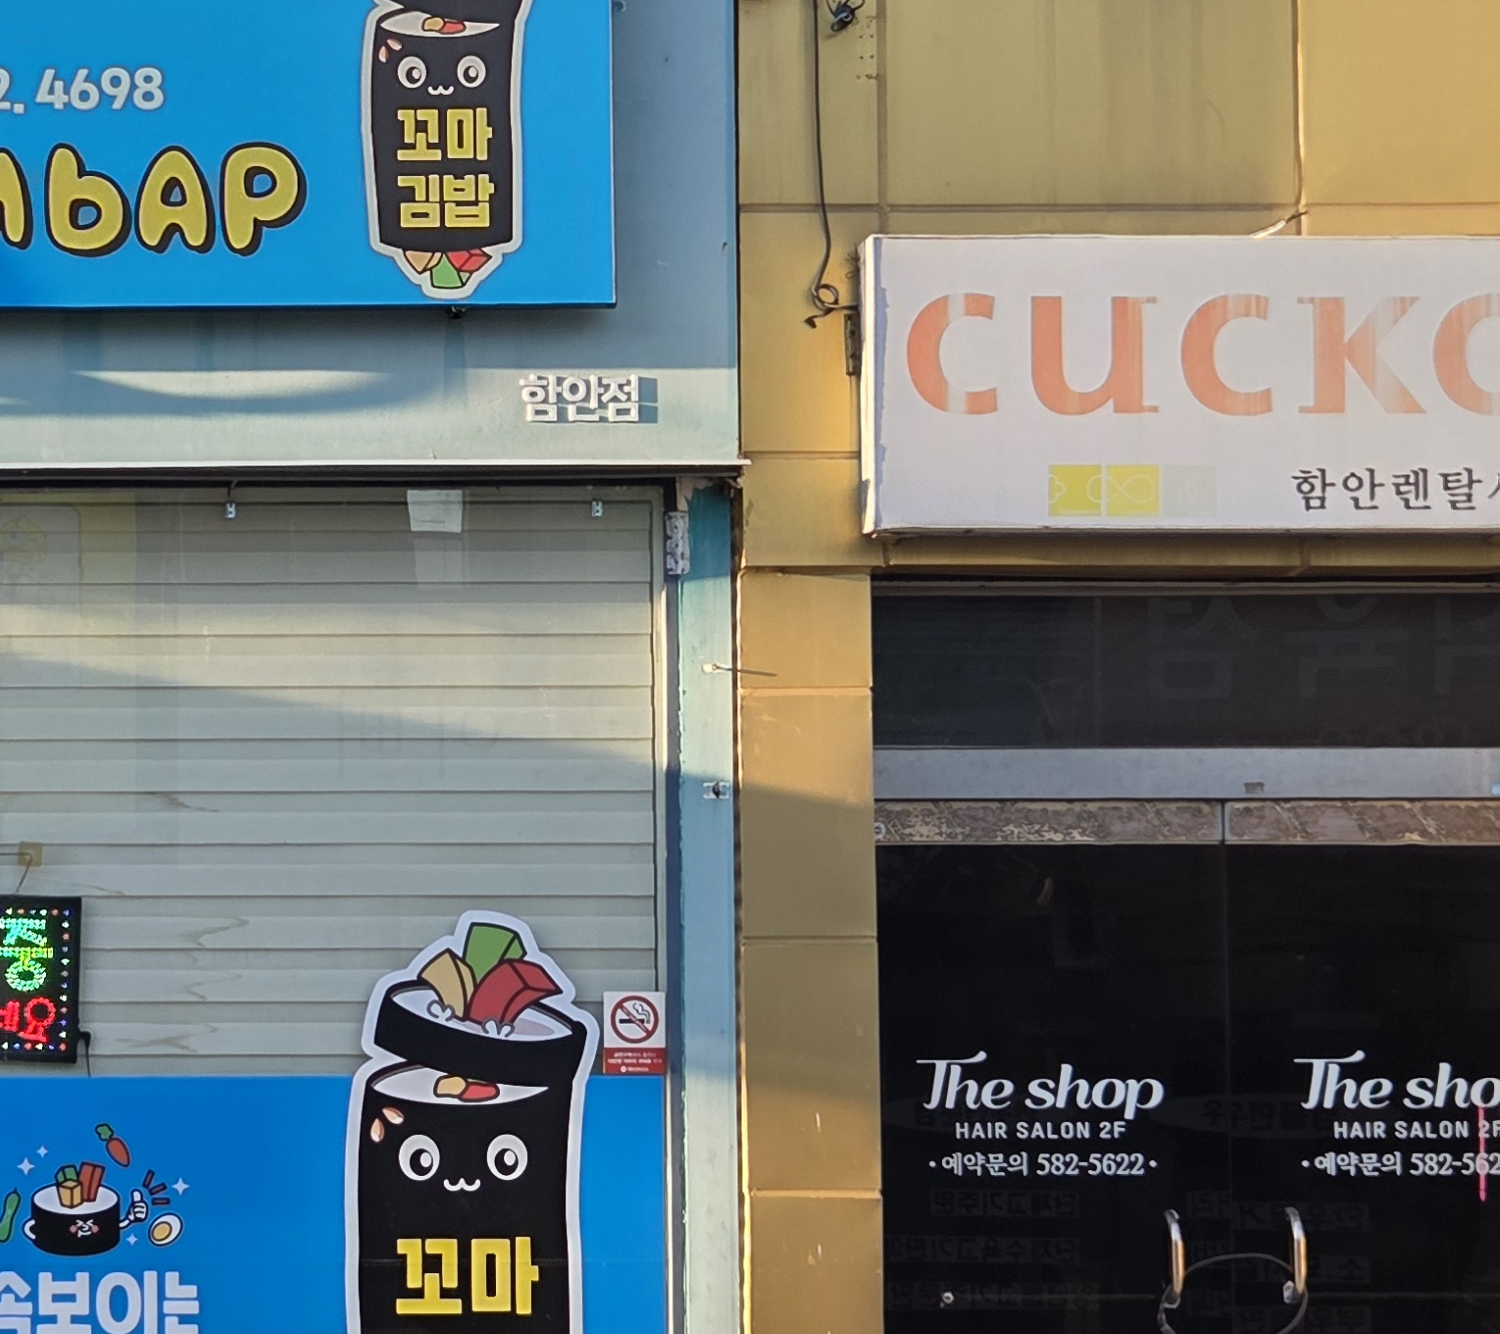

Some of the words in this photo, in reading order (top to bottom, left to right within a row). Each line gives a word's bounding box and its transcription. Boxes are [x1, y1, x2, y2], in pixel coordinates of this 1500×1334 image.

[396, 107, 493, 161] 꼬마
[396, 172, 495, 230] 김밥
[519, 373, 640, 423] 함안점
[1291, 467, 1500, 512] 함안렌탈
[916, 1050, 1015, 1110] The
[1024, 1063, 1165, 1120] shop
[1293, 1049, 1394, 1110] The
[955, 1121, 1008, 1139] HAIR
[1016, 1121, 1090, 1139] SALON
[1099, 1120, 1127, 1139] 2F
[1333, 1120, 1387, 1139] HAIR
[1394, 1120, 1469, 1139] SALON
[941, 1151, 1029, 1177] 예약문의
[1036, 1153, 1145, 1176] 582-5622
[1314, 1151, 1403, 1177] 예약문의
[396, 1235, 540, 1316] 꼬마
